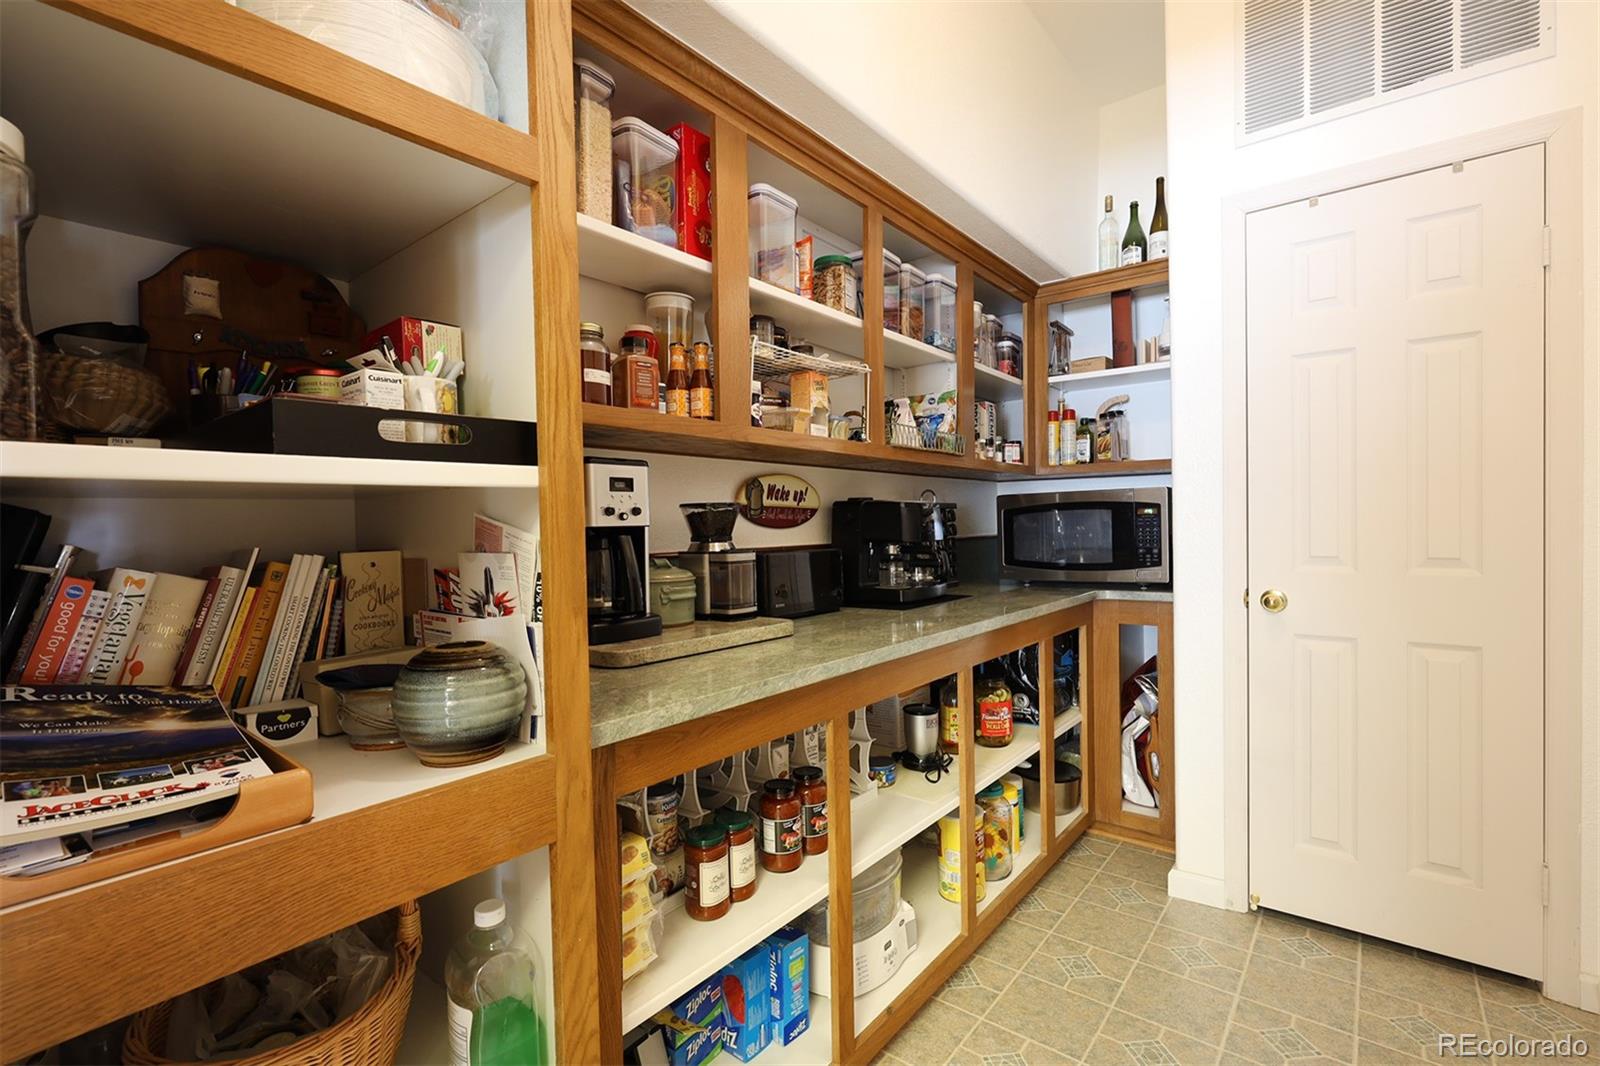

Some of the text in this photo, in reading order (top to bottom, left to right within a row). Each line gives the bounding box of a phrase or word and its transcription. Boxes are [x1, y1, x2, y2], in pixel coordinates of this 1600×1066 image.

[368, 374, 402, 385] Cuisinart
[766, 483, 809, 507] Wake up!
[54, 601, 75, 634] good
[196, 576, 235, 665] ULTRAMETABOLISM
[47, 634, 66, 653] for
[90, 593, 146, 684] Vegetarian
[33, 653, 53, 681] you!
[1, 686, 110, 702] Ready
[261, 720, 306, 734] Partners
[686, 985, 712, 1020] Ziploc
[721, 1027, 738, 1049] Zip
